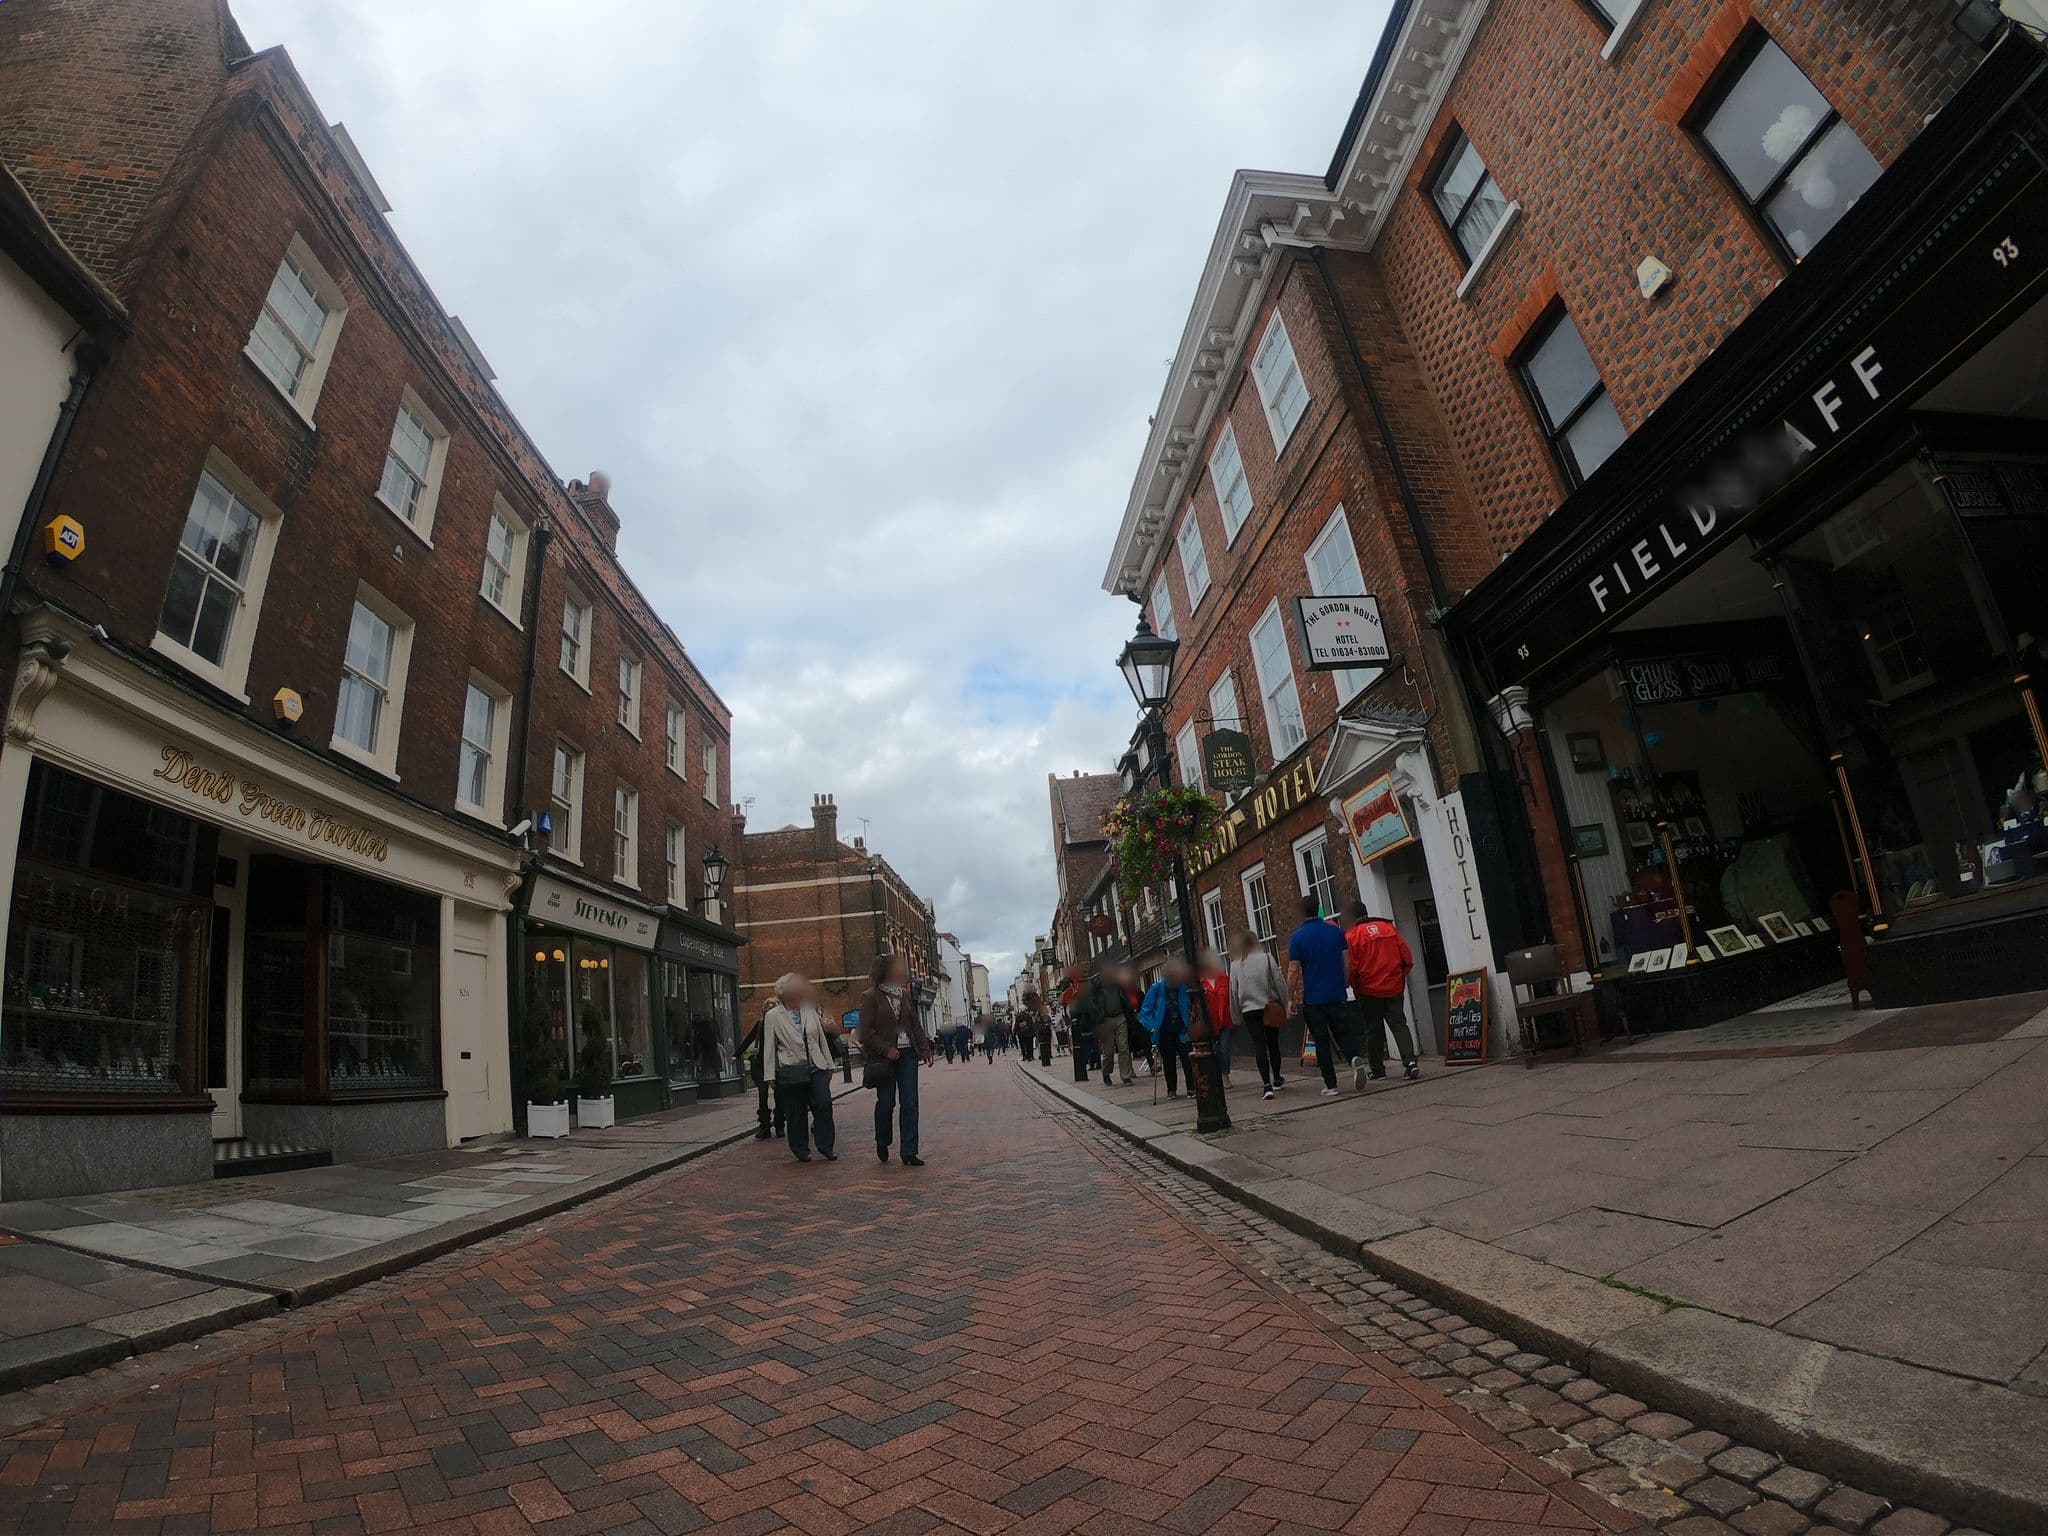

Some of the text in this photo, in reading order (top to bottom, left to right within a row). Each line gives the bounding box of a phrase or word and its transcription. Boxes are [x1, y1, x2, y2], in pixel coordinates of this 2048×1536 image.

[1992, 235, 2019, 268] 93
[1588, 345, 1884, 614] FIELDAFF
[60, 529, 79, 547] ADT
[1305, 602, 1380, 627] THE GORDON HOUSE
[1335, 635, 1359, 644] HOTEL
[1315, 646, 1385, 657] TEL 01634-831000
[1517, 643, 1530, 661] 93
[1636, 679, 1682, 701] GLASS
[1212, 758, 1246, 769] STEAK
[1213, 751, 1243, 760] GORDON
[1213, 767, 1248, 778] HOUSE
[1254, 755, 1318, 829] HOTEL
[153, 745, 389, 862] Denis Green Jewellers
[1446, 806, 1481, 940] HOTEL
[1453, 1024, 1478, 1038] market
